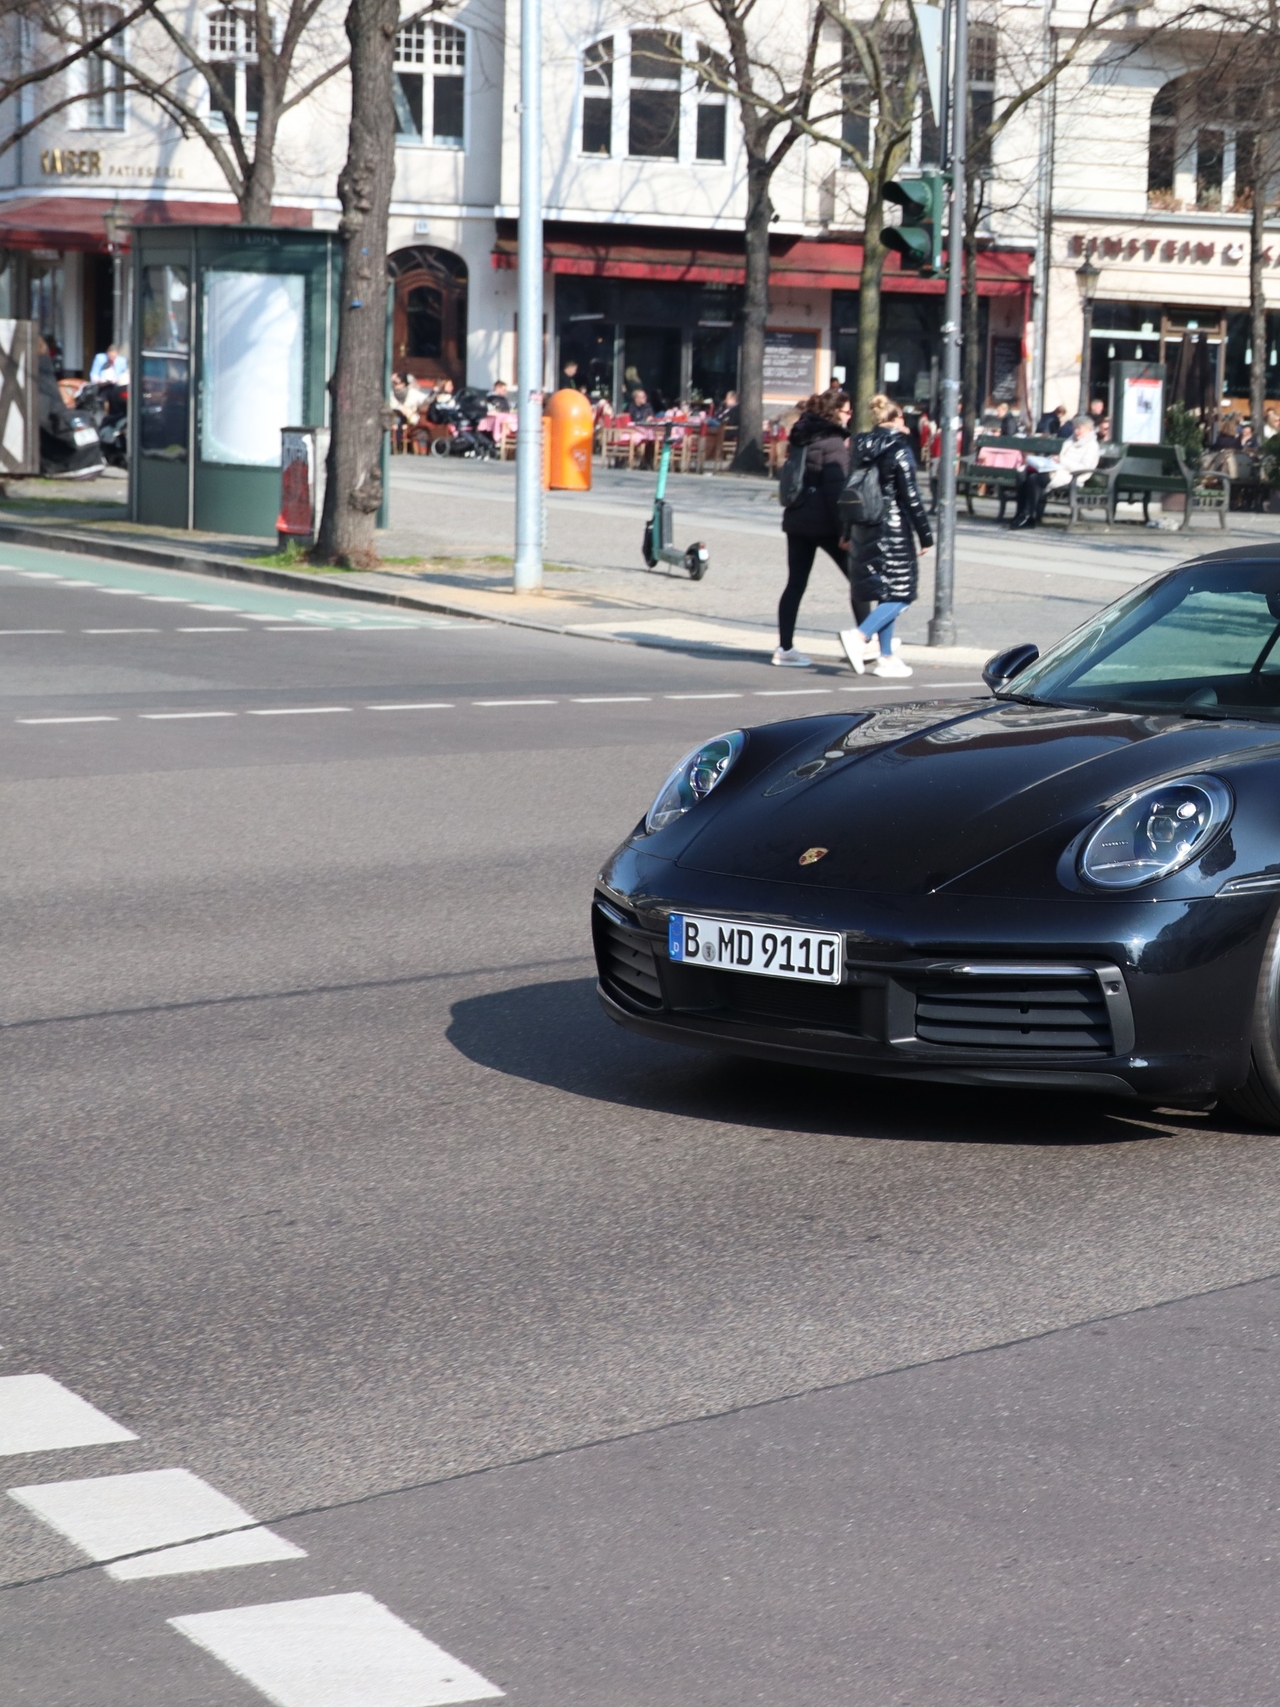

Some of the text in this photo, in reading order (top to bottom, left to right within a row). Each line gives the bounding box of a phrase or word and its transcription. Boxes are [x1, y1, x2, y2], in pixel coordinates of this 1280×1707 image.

[40, 148, 101, 175] KAISER
[1070, 234, 1215, 262] EINSTEIN
[685, 921, 836, 976] B MD 9110
